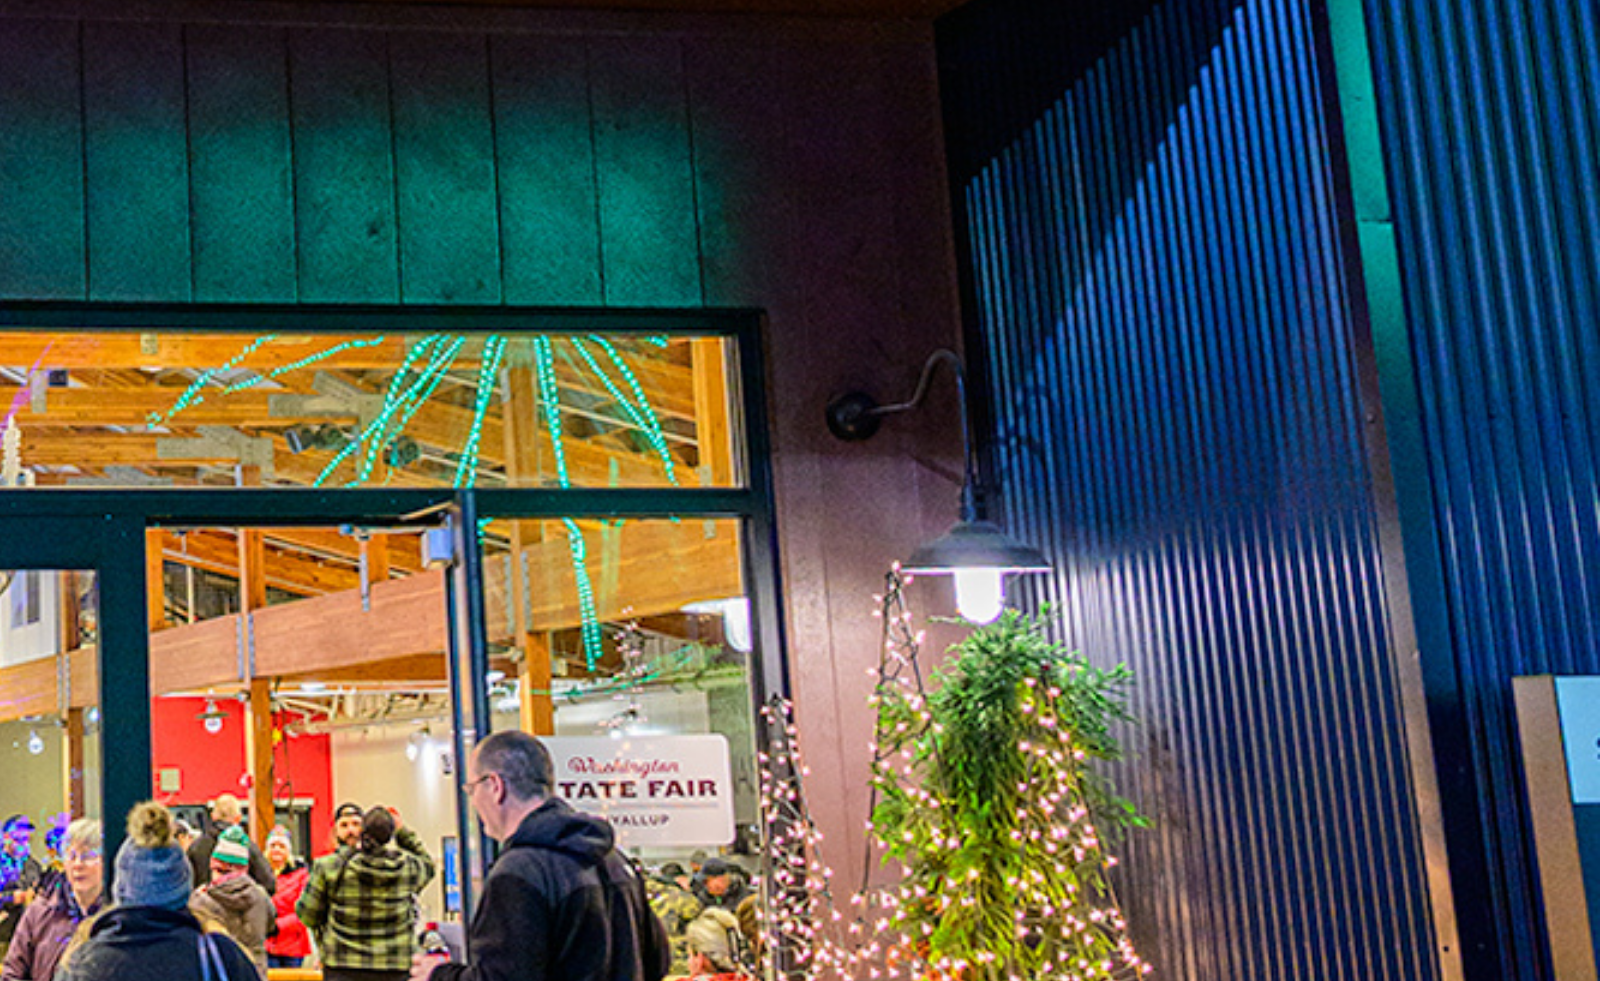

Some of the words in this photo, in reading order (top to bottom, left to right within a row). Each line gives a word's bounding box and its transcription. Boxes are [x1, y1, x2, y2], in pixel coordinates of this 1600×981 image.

[568, 756, 680, 779] Washington
[557, 779, 637, 799] TATE
[648, 779, 718, 797] FAIR
[607, 814, 670, 827] YALLUP
